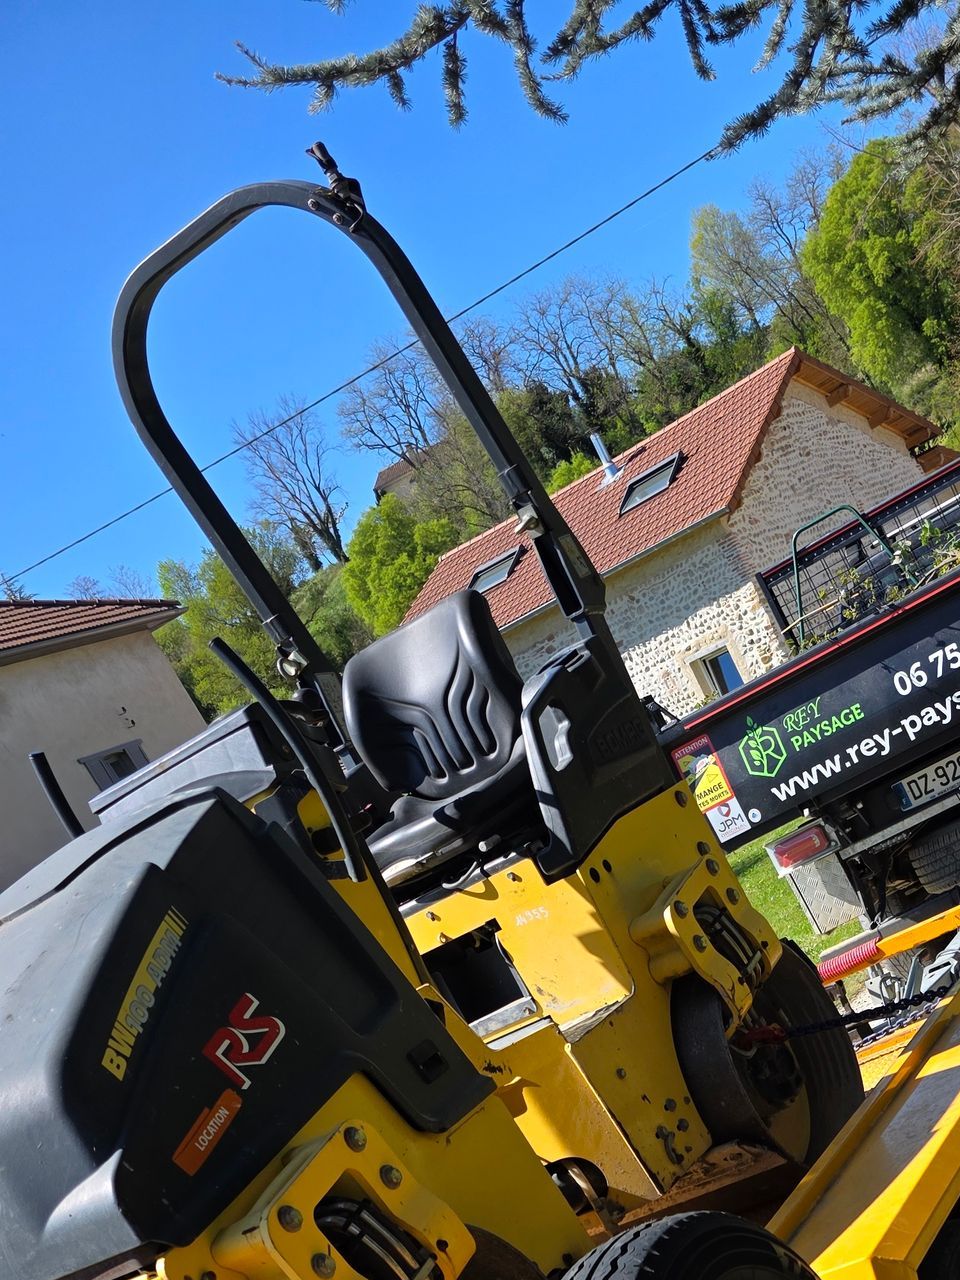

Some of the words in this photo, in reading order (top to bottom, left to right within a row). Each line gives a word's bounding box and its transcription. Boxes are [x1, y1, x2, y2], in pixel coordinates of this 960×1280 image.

[893, 662, 928, 696] 06
[783, 696, 821, 733] REY
[790, 703, 865, 752] PAYSAGE
[674, 736, 709, 760] ATTENTION
[696, 781, 724, 801] MANGE
[699, 800, 710, 809] TES
[709, 790, 730, 803] MORTS
[718, 813, 745, 833] JPM
[146, 928, 182, 989] ADM
[202, 992, 286, 1090] RS
[194, 1106, 230, 1151] LOCATION
